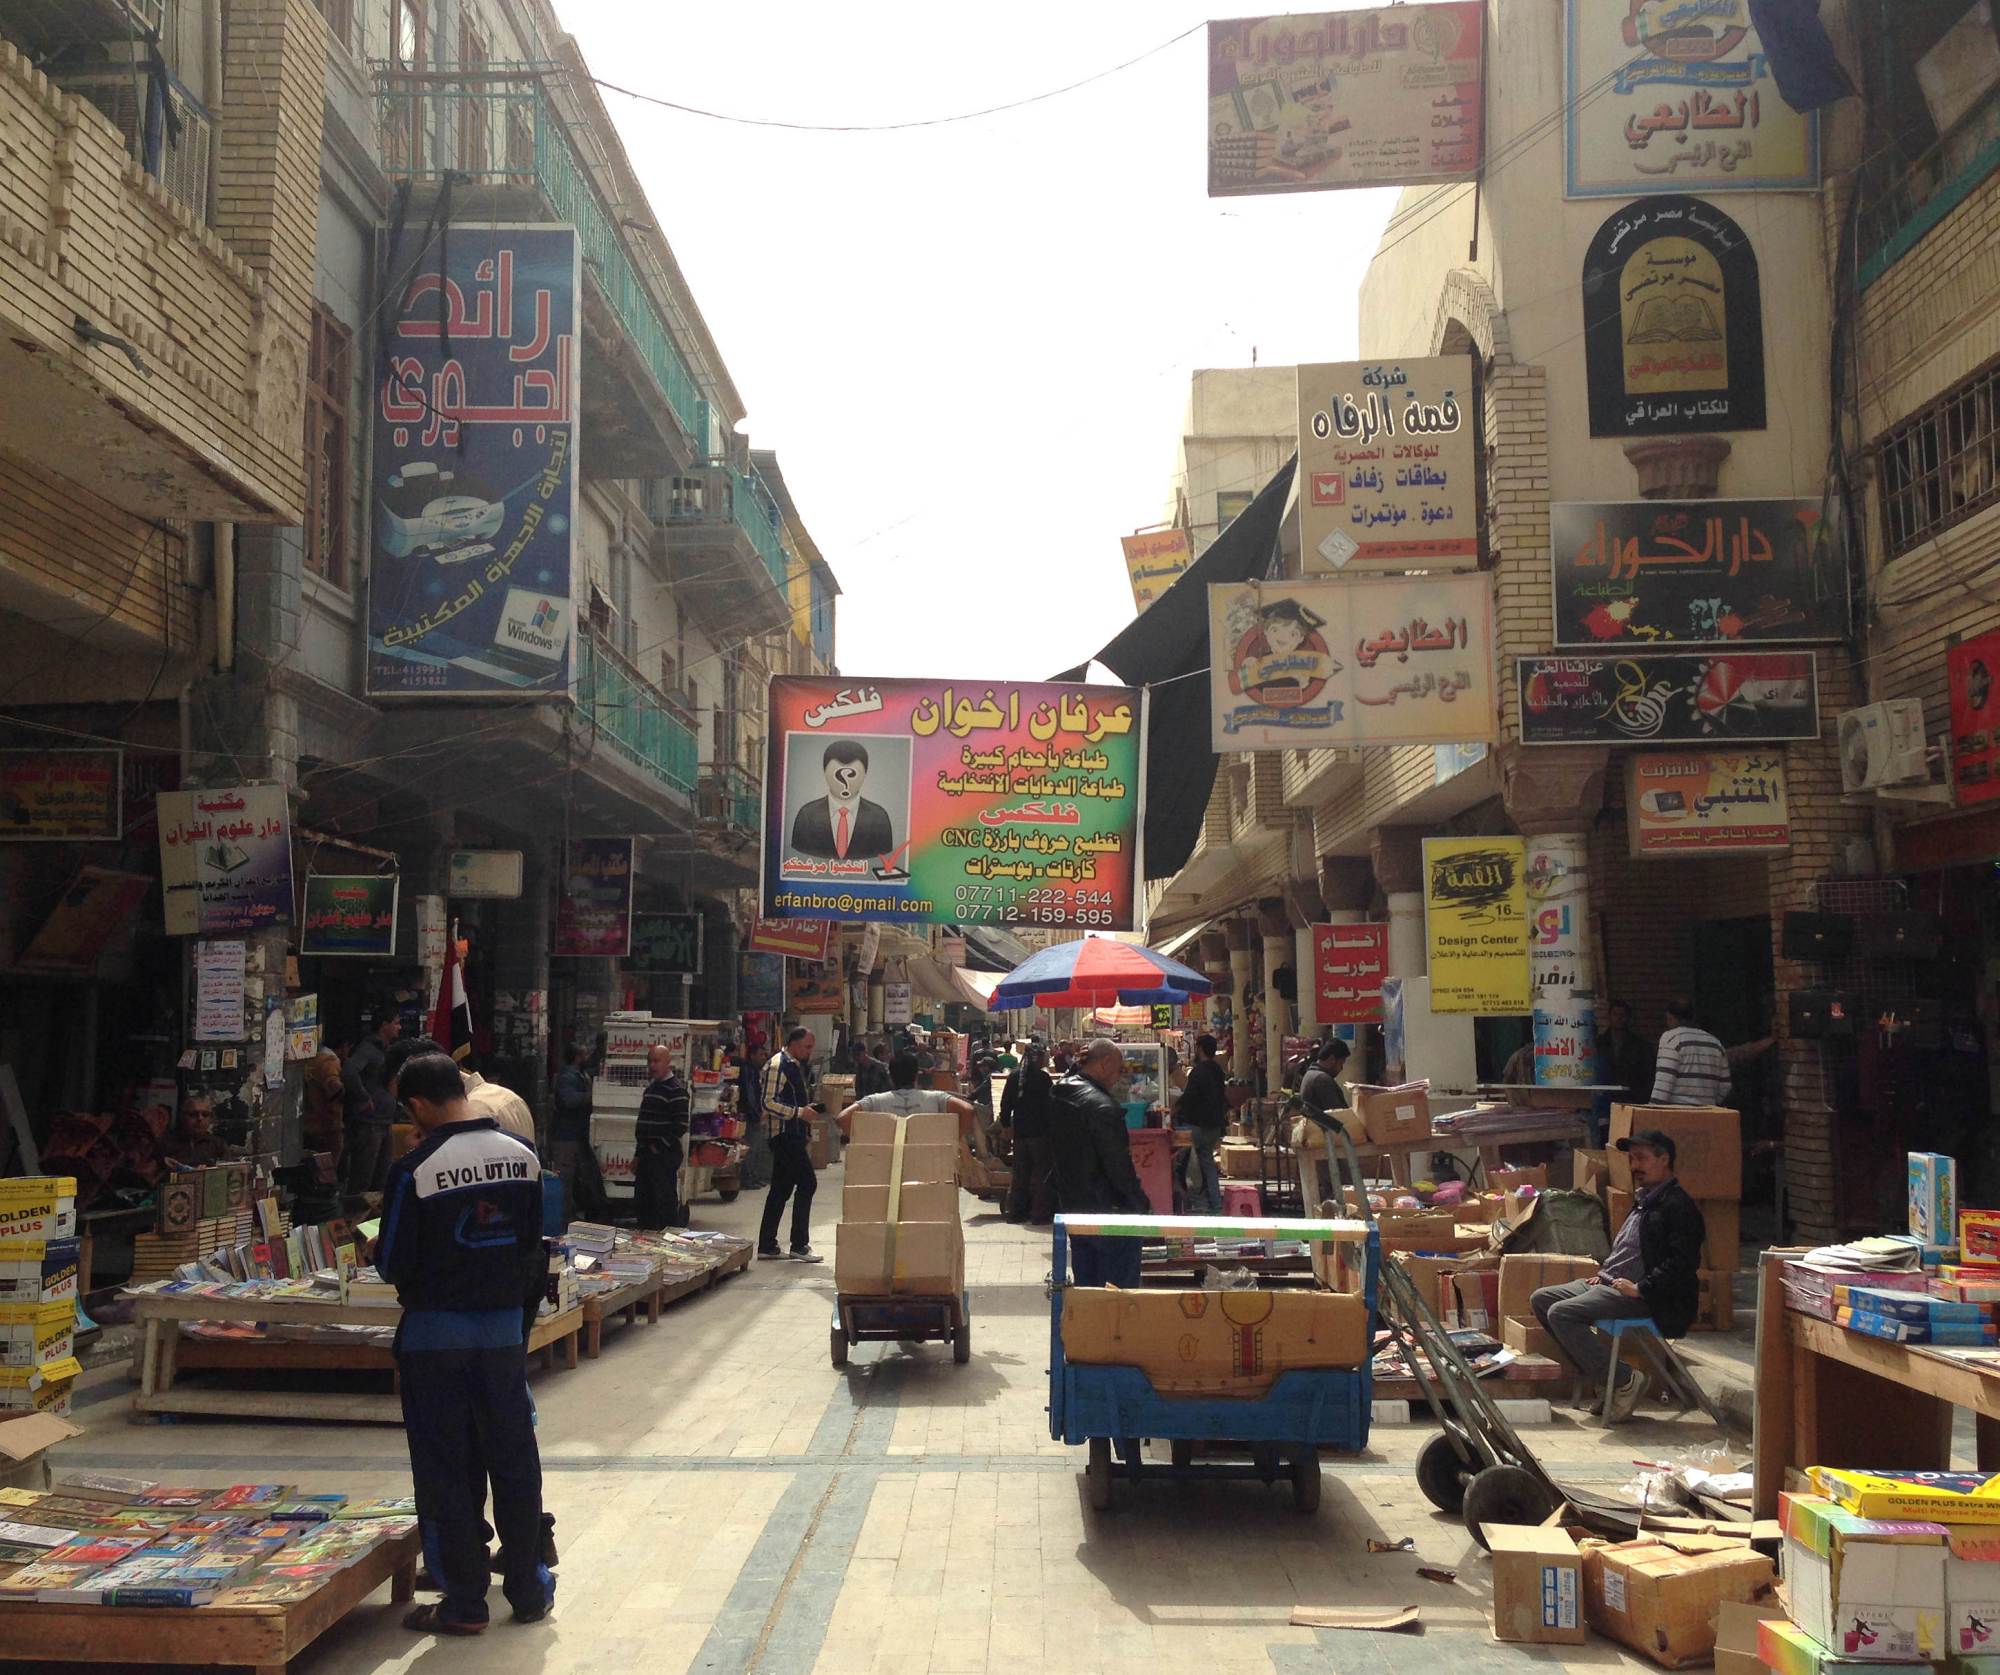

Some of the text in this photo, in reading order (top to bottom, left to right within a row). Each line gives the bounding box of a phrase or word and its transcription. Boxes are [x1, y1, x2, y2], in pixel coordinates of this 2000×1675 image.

[1624, 89, 1760, 149] الطابعي
[397, 249, 551, 363] رائد
[1362, 366, 1407, 390] شركة
[381, 335, 573, 449] الجبوري
[1311, 392, 1396, 446] الرفاه
[1626, 400, 1729, 426] للكتاب العراقي
[1392, 444, 1440, 461] للوكالات
[1348, 463, 1447, 493] بطاقات زفاف
[1351, 503, 1407, 527] مؤتمرات
[1420, 500, 1454, 525] دعوة
[1574, 516, 1774, 580] دار الحوراء
[383, 580, 485, 648] المكتبية
[507, 622, 553, 651] Windows
[1355, 616, 1470, 669] الطابعي
[803, 687, 883, 728] فلكس
[911, 687, 1134, 742] عرفان اخوان
[961, 745, 1108, 771] طباعة بأحجام كبيرة
[1744, 755, 1780, 772] مركز
[937, 771, 1125, 801] طباعة الدعايات الانتخابية
[1693, 777, 1778, 818] المتنبي
[198, 793, 245, 818] مكتبة
[978, 802, 1080, 826] فلكس
[216, 818, 255, 843] علوم
[258, 816, 281, 840] دار
[941, 829, 1122, 854] تقطيع حروف بارزة CNC
[964, 857, 1034, 881] بوسترات
[1045, 860, 1097, 883] كارتات
[774, 893, 934, 915] erfanbro@gmail.com
[955, 885, 1113, 906] 07711-222-544
[955, 904, 1113, 926] 07712-159-595
[1495, 903, 1512, 916] 16
[1438, 934, 1520, 948] Design Center
[1322, 955, 1381, 977] فورية
[436, 1161, 528, 1190] EVOLUTION
[601, 1151, 636, 1177] وبايل
[0, 1204, 52, 1223] OLDEN
[0, 1220, 43, 1237] PLUS
[44, 1263, 77, 1287] GOLDEN
[50, 1279, 73, 1297] PLUS
[38, 1324, 73, 1351] GOLDEN
[44, 1341, 68, 1361] PLUS
[1887, 1497, 1929, 1506] GOLDEN
[1930, 1499, 1957, 1507] PLUS
[1957, 1500, 1984, 1508] Extra
[1903, 1506, 1929, 1514] Multi
[1930, 1507, 1969, 1516] Purpose
